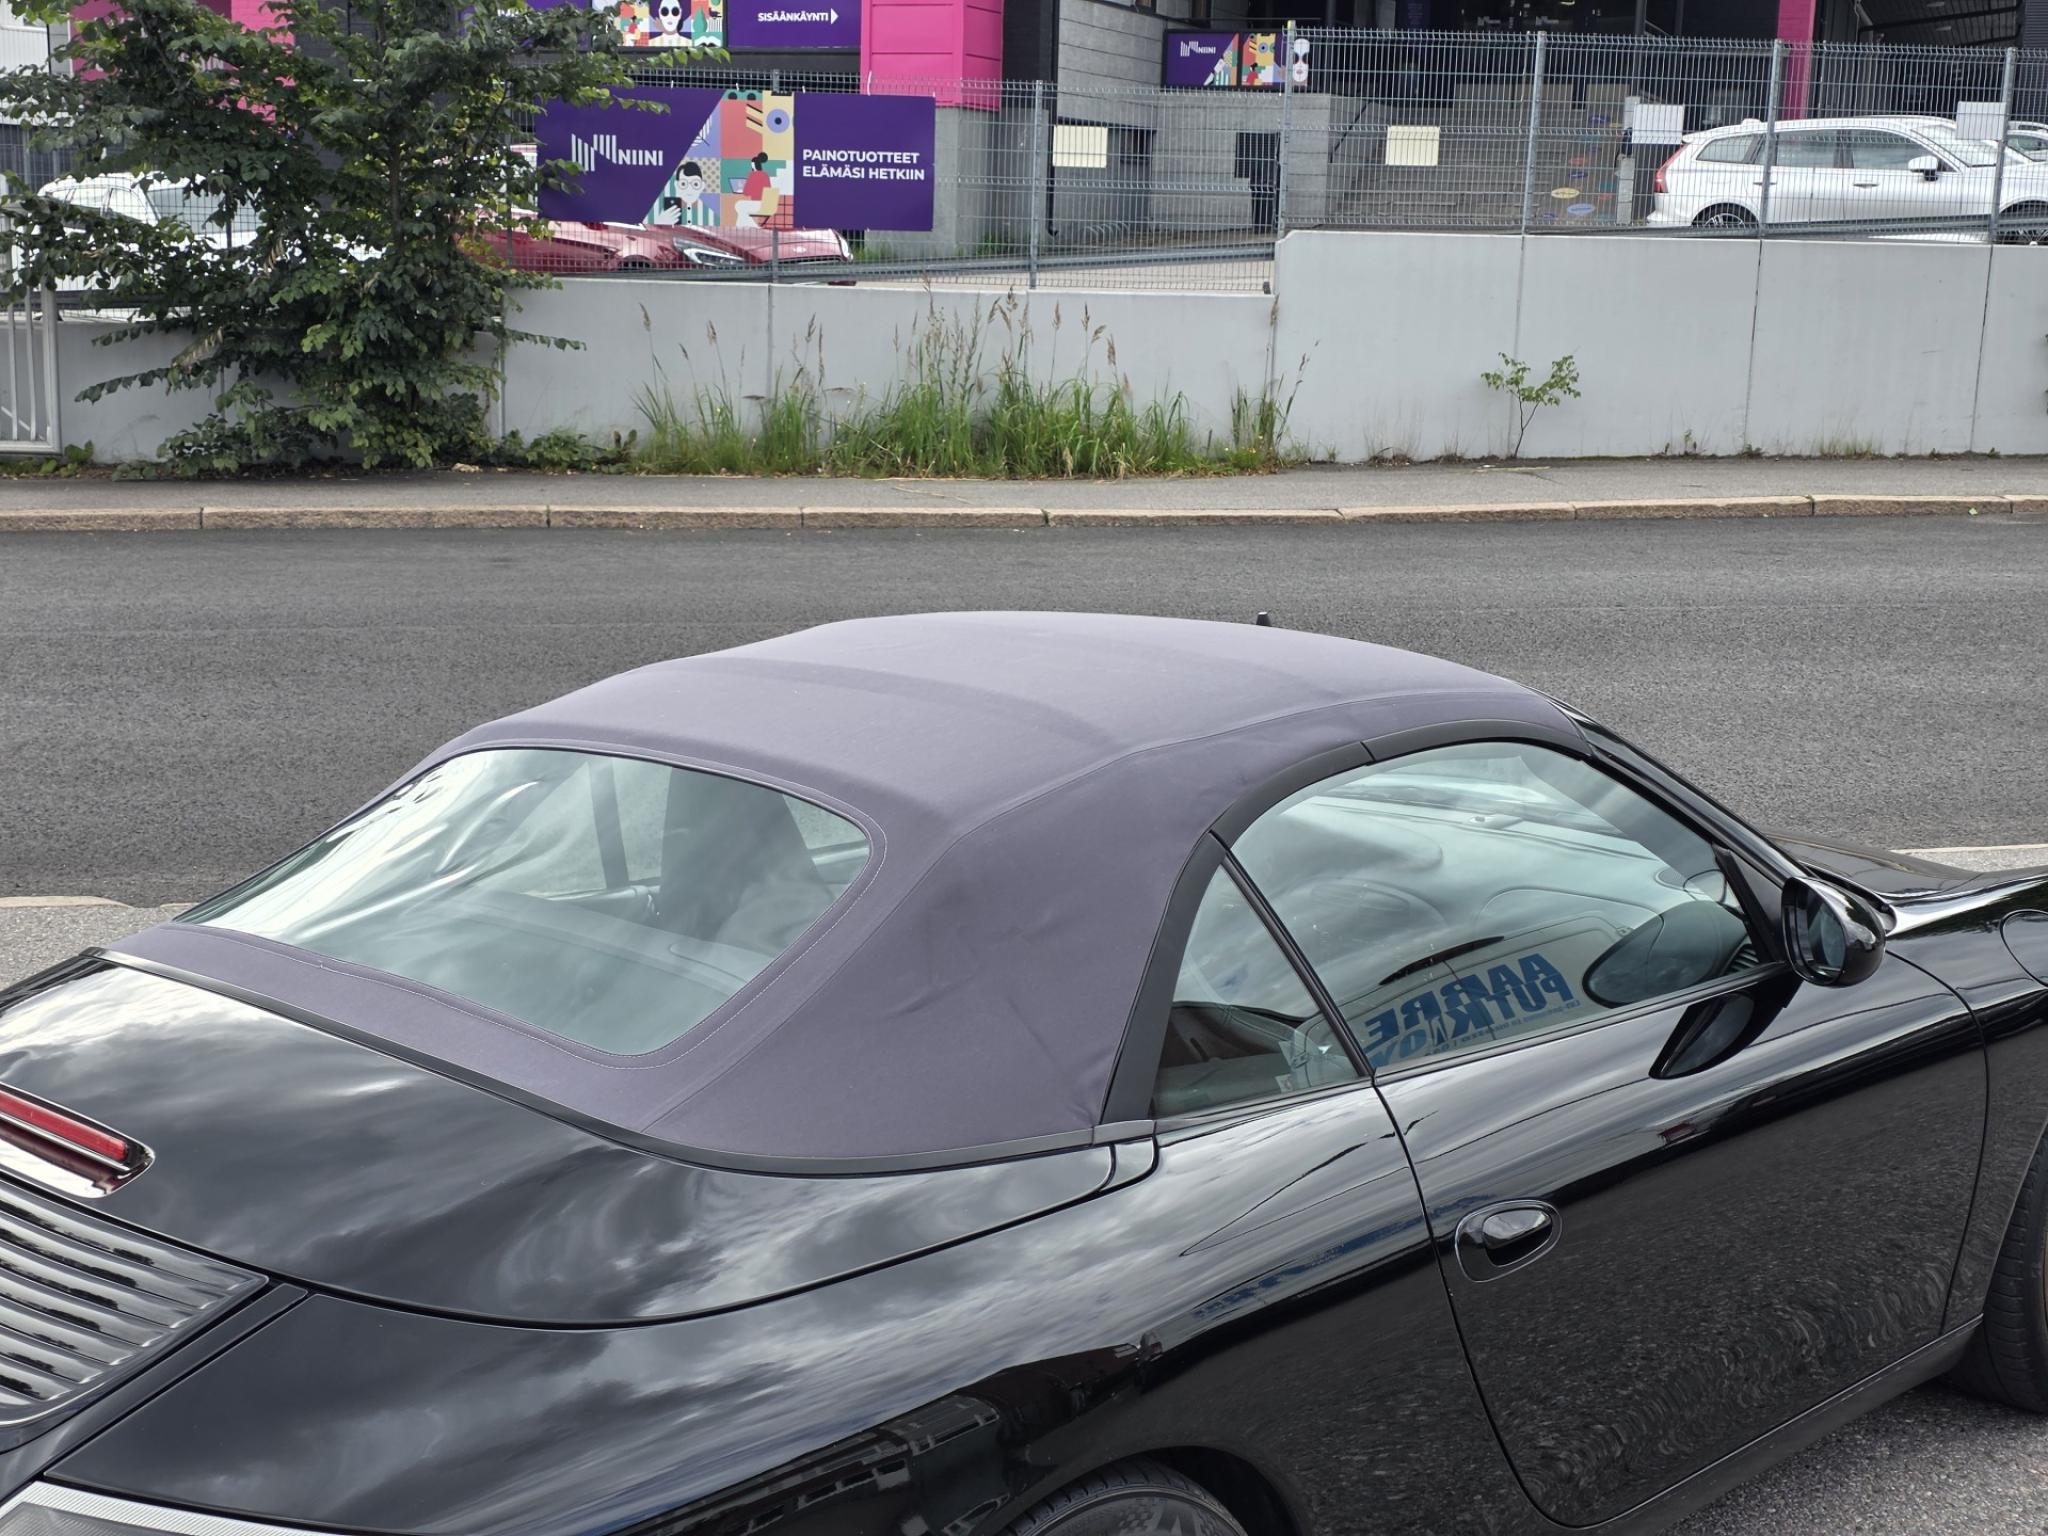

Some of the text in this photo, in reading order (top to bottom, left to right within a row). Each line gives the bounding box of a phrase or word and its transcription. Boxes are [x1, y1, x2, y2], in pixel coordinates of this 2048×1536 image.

[757, 10, 829, 22] SISÄÄNKÄYNTI
[802, 149, 920, 164] PAINOTUOTTEET
[802, 164, 925, 181] ELÄMÄSI HETKIIN
